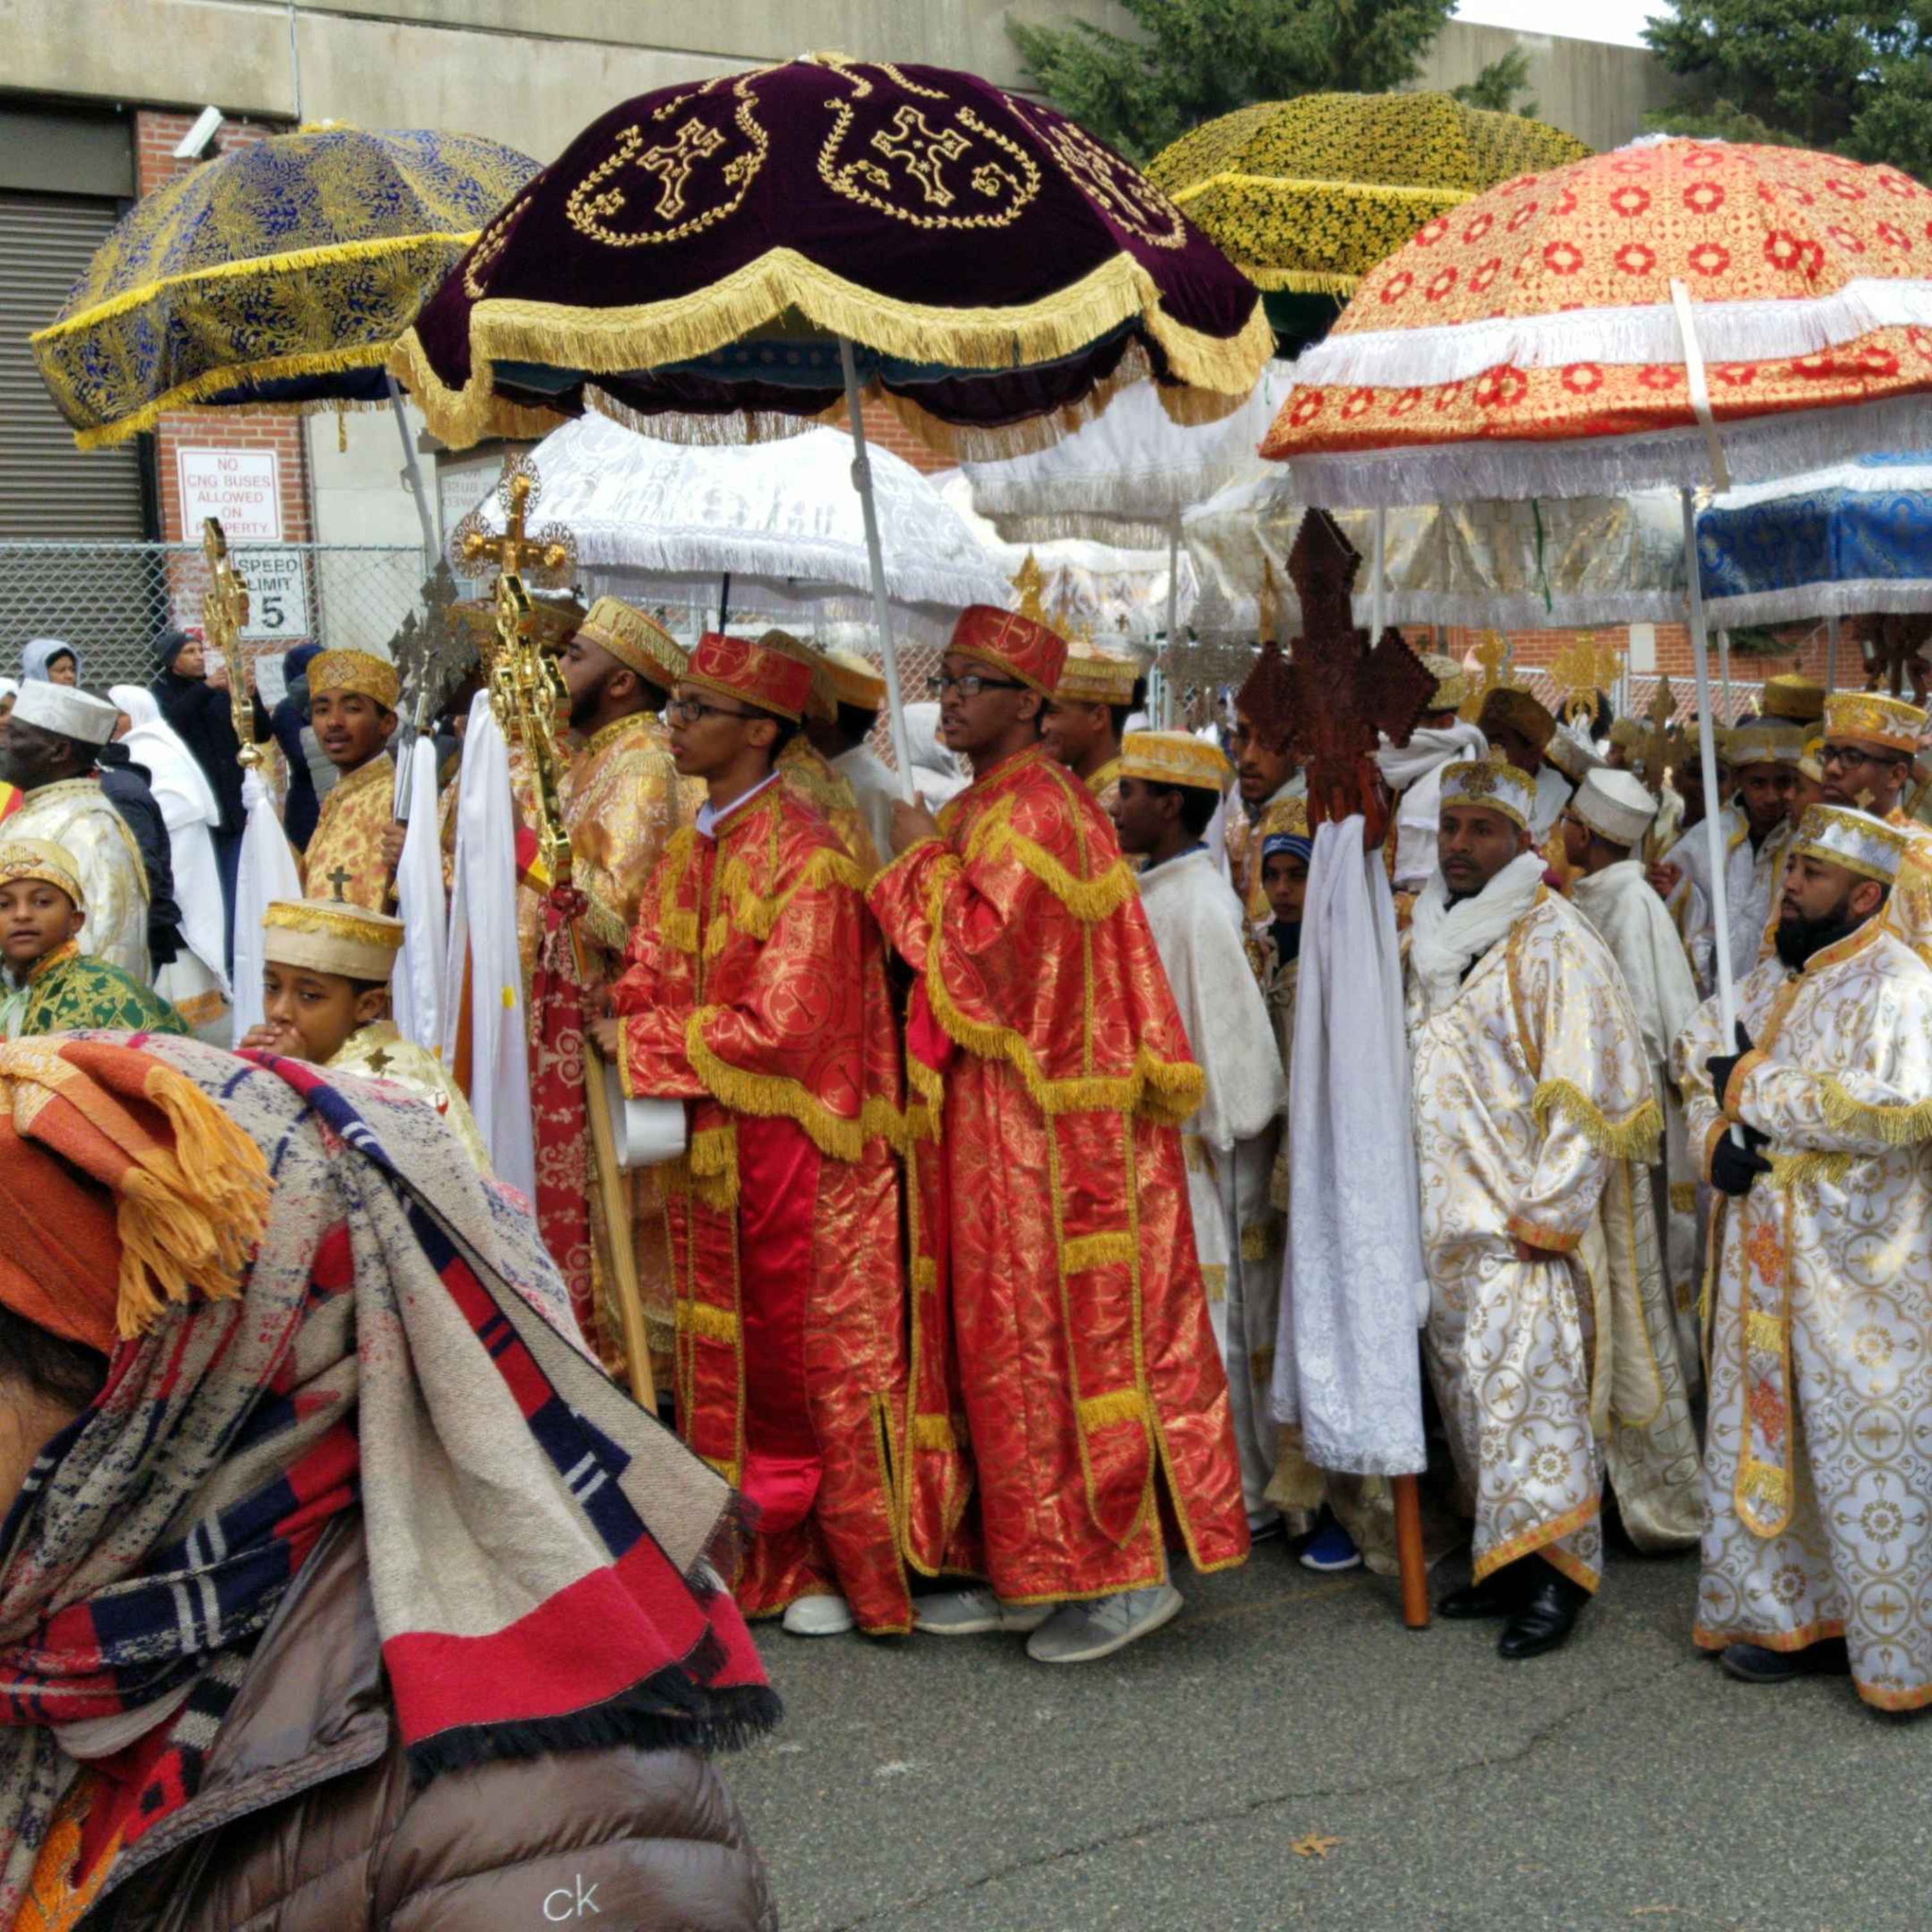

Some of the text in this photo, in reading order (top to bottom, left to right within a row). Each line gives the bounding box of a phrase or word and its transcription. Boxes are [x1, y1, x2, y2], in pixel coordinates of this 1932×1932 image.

[218, 458, 238, 471] NO
[187, 475, 270, 488] CNG BUSES
[198, 491, 263, 503] ALLOWED
[222, 507, 242, 518] ON
[196, 522, 267, 533] PPERTY
[238, 558, 298, 573] SPEED
[247, 578, 292, 591] LIMIT
[262, 596, 285, 629] 5
[544, 1873, 601, 1921] ck
